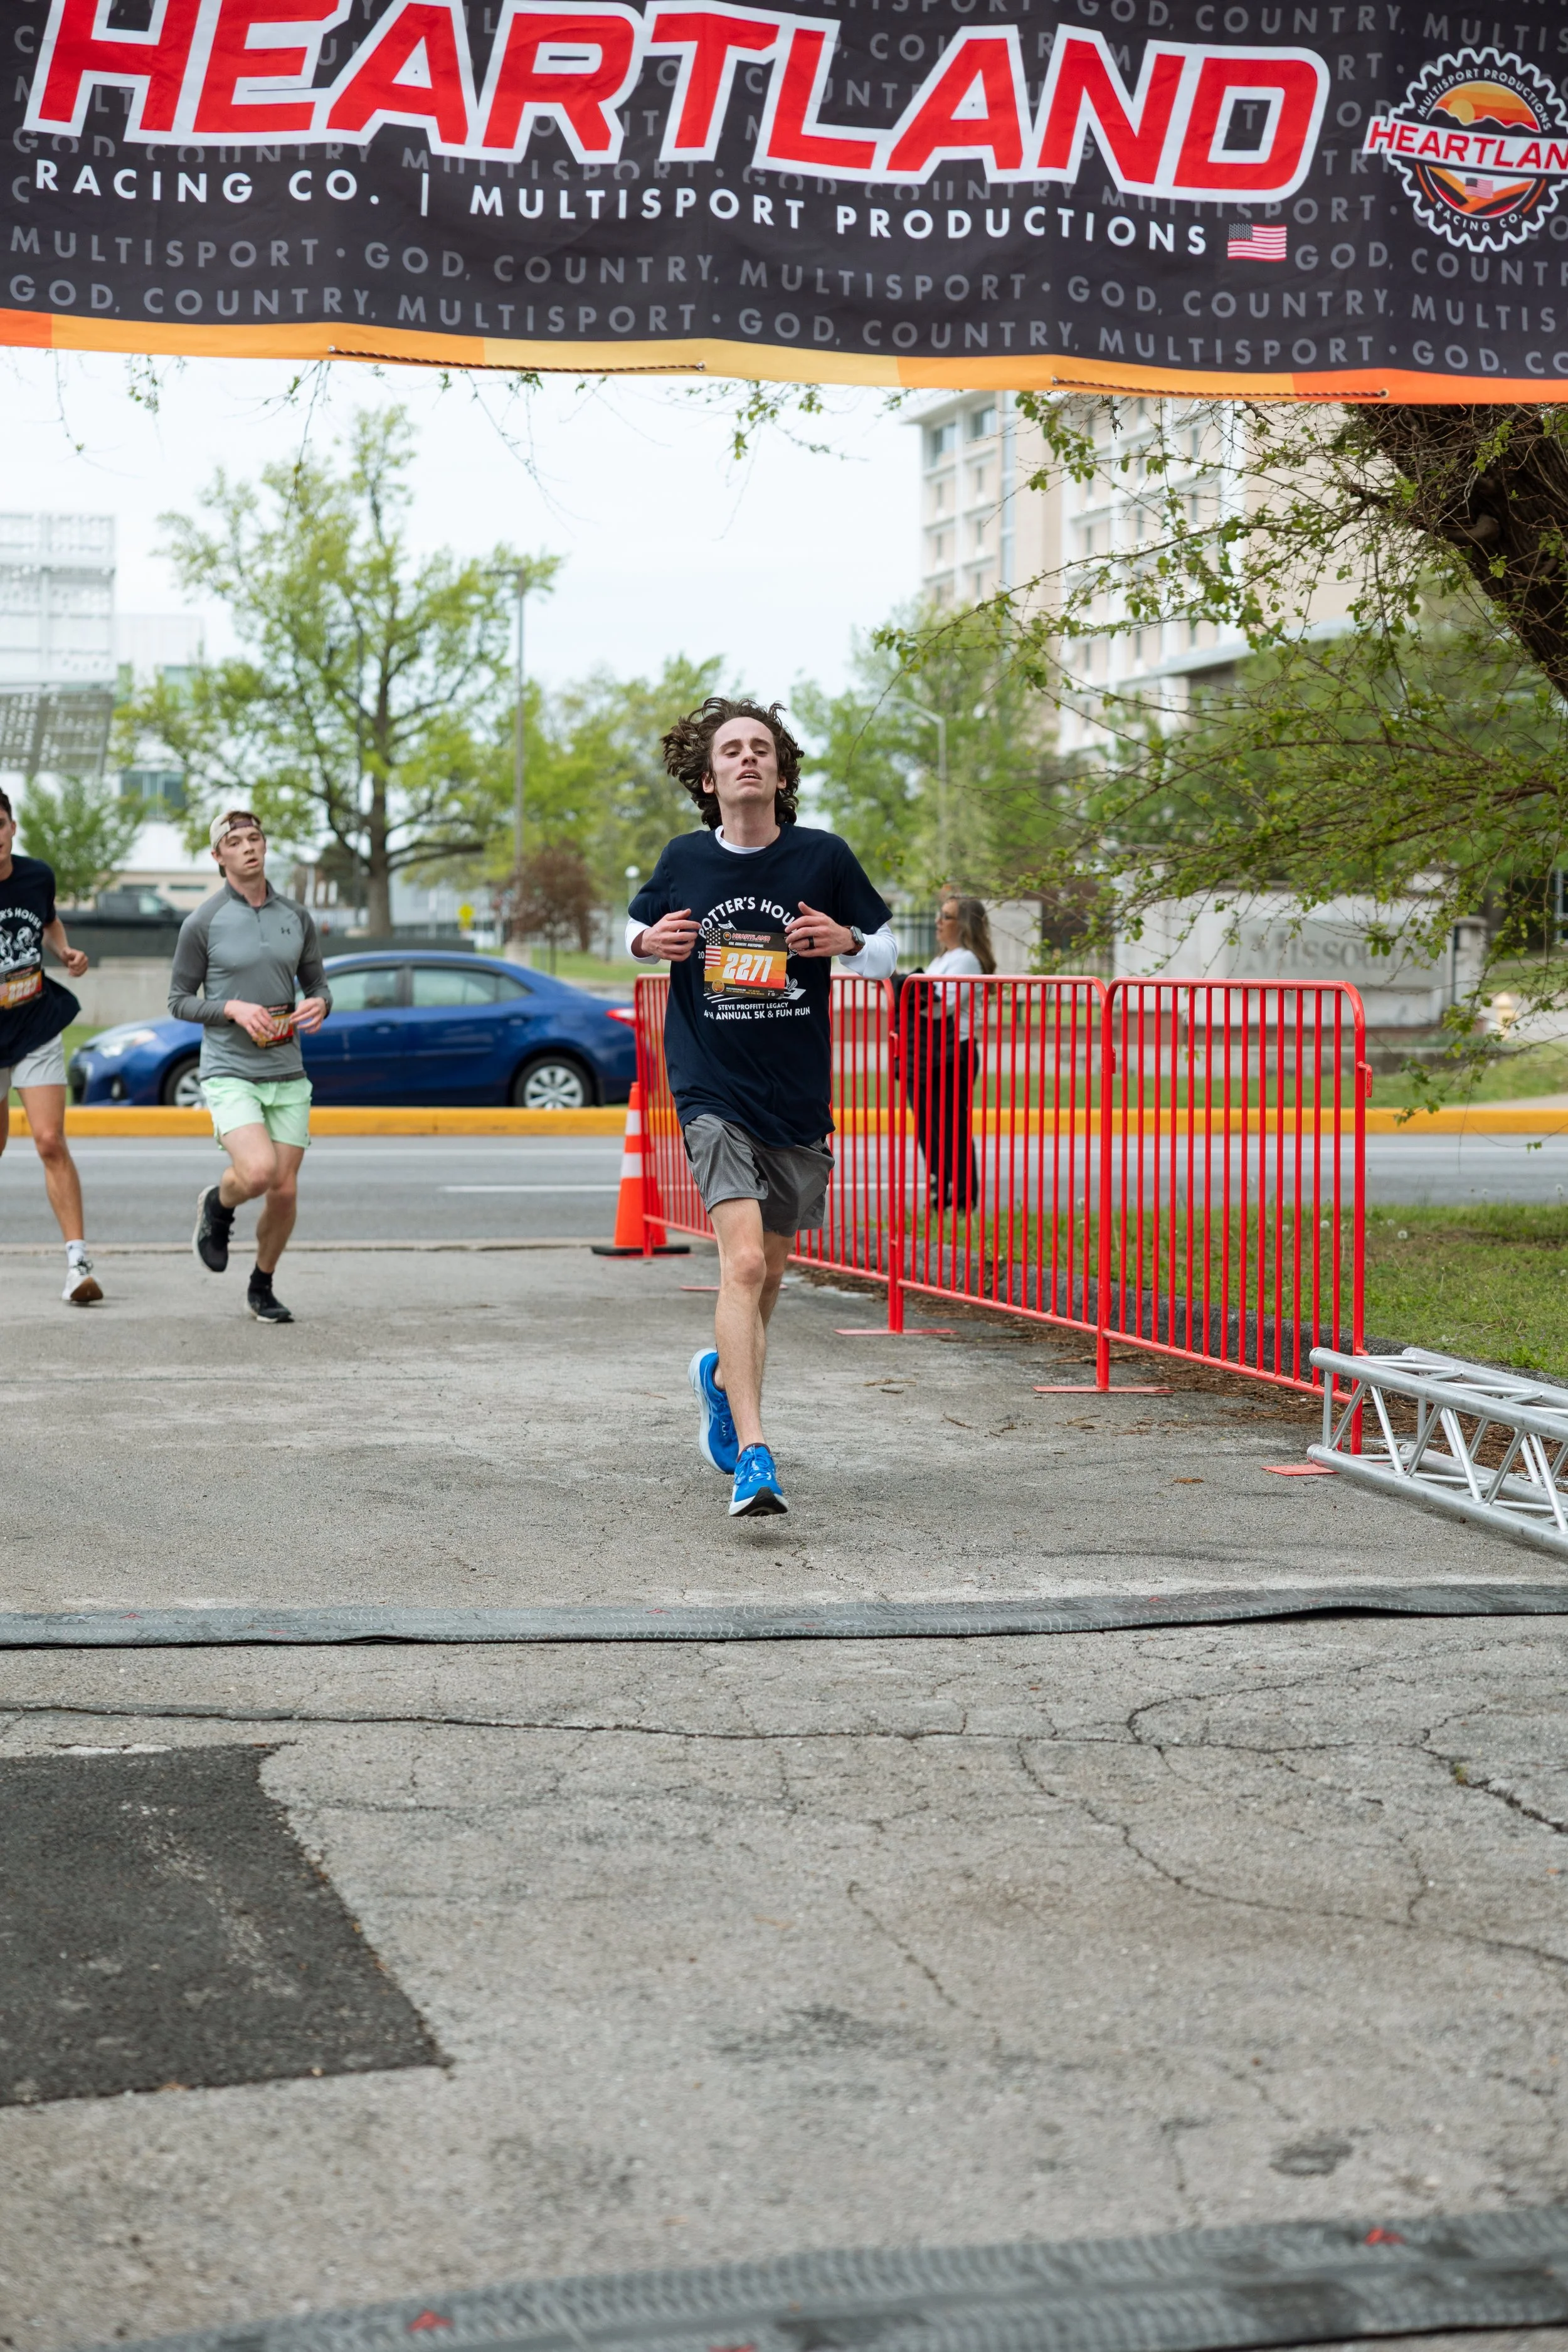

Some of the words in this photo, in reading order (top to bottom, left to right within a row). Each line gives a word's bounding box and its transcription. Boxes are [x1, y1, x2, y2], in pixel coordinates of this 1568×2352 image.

[1195, 4, 1405, 34] COUNTRY,
[24, 0, 1331, 204] HEARTLAND
[1417, 68, 1479, 117] MULTISPORT
[1484, 68, 1552, 131] PRODUCTIONS
[1367, 120, 1568, 171] HEARTLAN
[36, 159, 253, 204] RACING
[289, 169, 379, 205] CO.
[469, 184, 805, 229] MULTISPORT
[837, 205, 1207, 255] PRODUCTIONS
[1435, 201, 1490, 232] RACING
[10, 226, 319, 268] MULTISPORT
[364, 242, 470, 281] GOD,
[494, 255, 719, 285] COUNTRY,
[739, 260, 1026, 301] MULTISPORT
[1067, 275, 1163, 315] GOD,
[1183, 289, 1394, 317] COUNTRY,
[1295, 242, 1393, 271] GOD,
[9, 274, 120, 313] GOD,
[143, 287, 376, 319] COUNTRY,
[398, 296, 696, 333] MULTISPORT
[739, 308, 840, 345] GOD,
[862, 320, 1079, 351] COUNTRY,
[1099, 327, 1374, 366] MULTISPORT
[1412, 340, 1507, 374] GOD,
[14, 907, 43, 930] HOUSE
[698, 896, 756, 939] POTTER'S
[760, 899, 796, 926] HOU
[732, 933, 771, 941] HEARTLAND
[722, 952, 773, 983] 2271
[1244, 930, 1407, 974] Missou
[704, 1009, 714, 1020] 4H
[716, 1011, 753, 1020] ANNUAL
[755, 1010, 766, 1019] 5K
[776, 1009, 793, 1018] FUN
[795, 1007, 811, 1016] RUN
